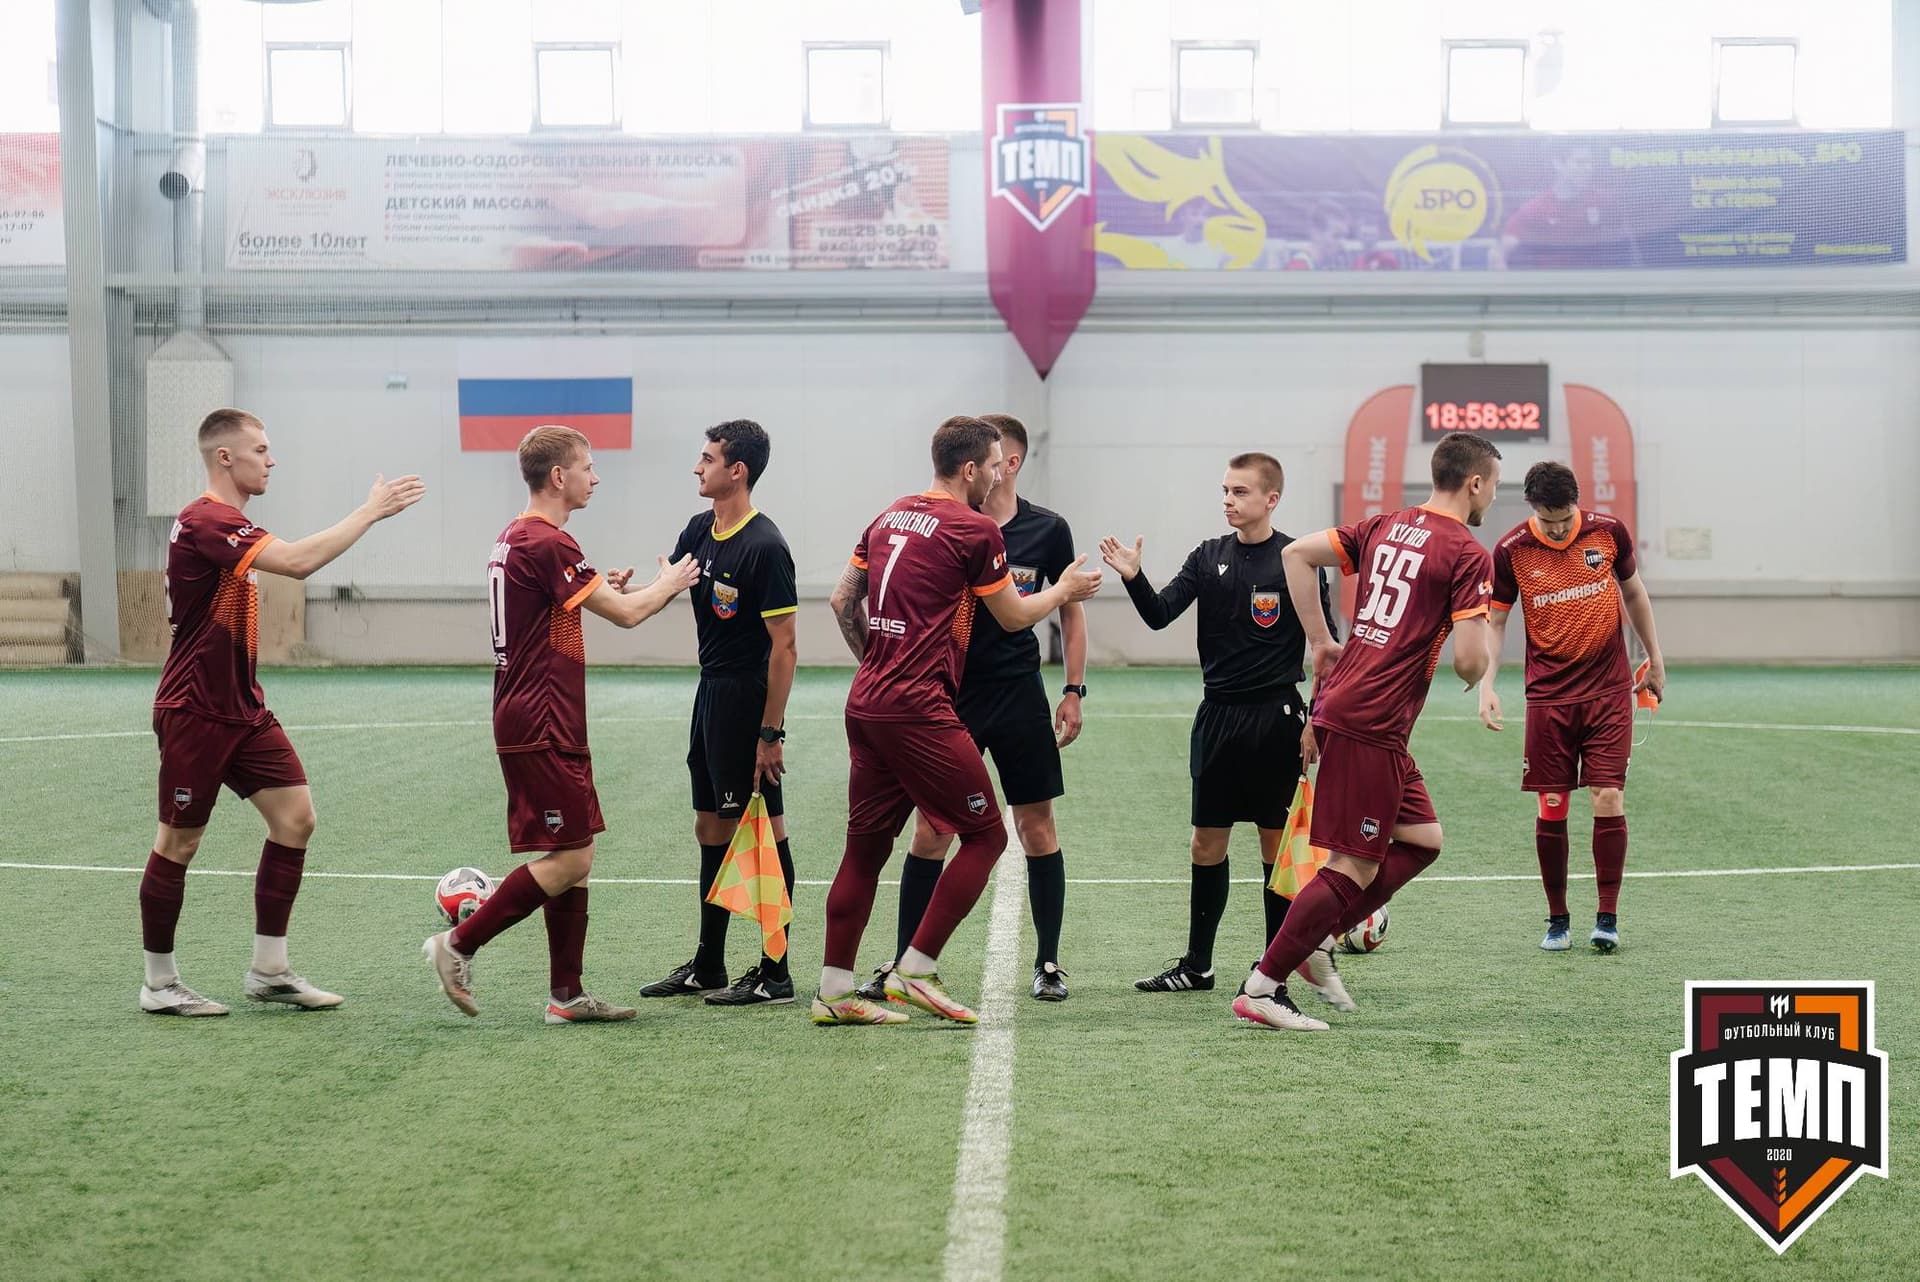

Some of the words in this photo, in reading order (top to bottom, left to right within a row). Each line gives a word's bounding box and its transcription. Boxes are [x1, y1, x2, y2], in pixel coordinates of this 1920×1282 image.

[1001, 139, 1081, 183] ТЕМП
[385, 195, 467, 211] ДЕТСКИЙ
[239, 231, 302, 249] более
[310, 231, 368, 249] 10лет
[1425, 402, 1541, 430] 18:58:32
[878, 510, 940, 538] ТРОЦЕНКО
[878, 534, 909, 611] 7
[1533, 579, 1609, 609] ПРОДИНВЕСТ
